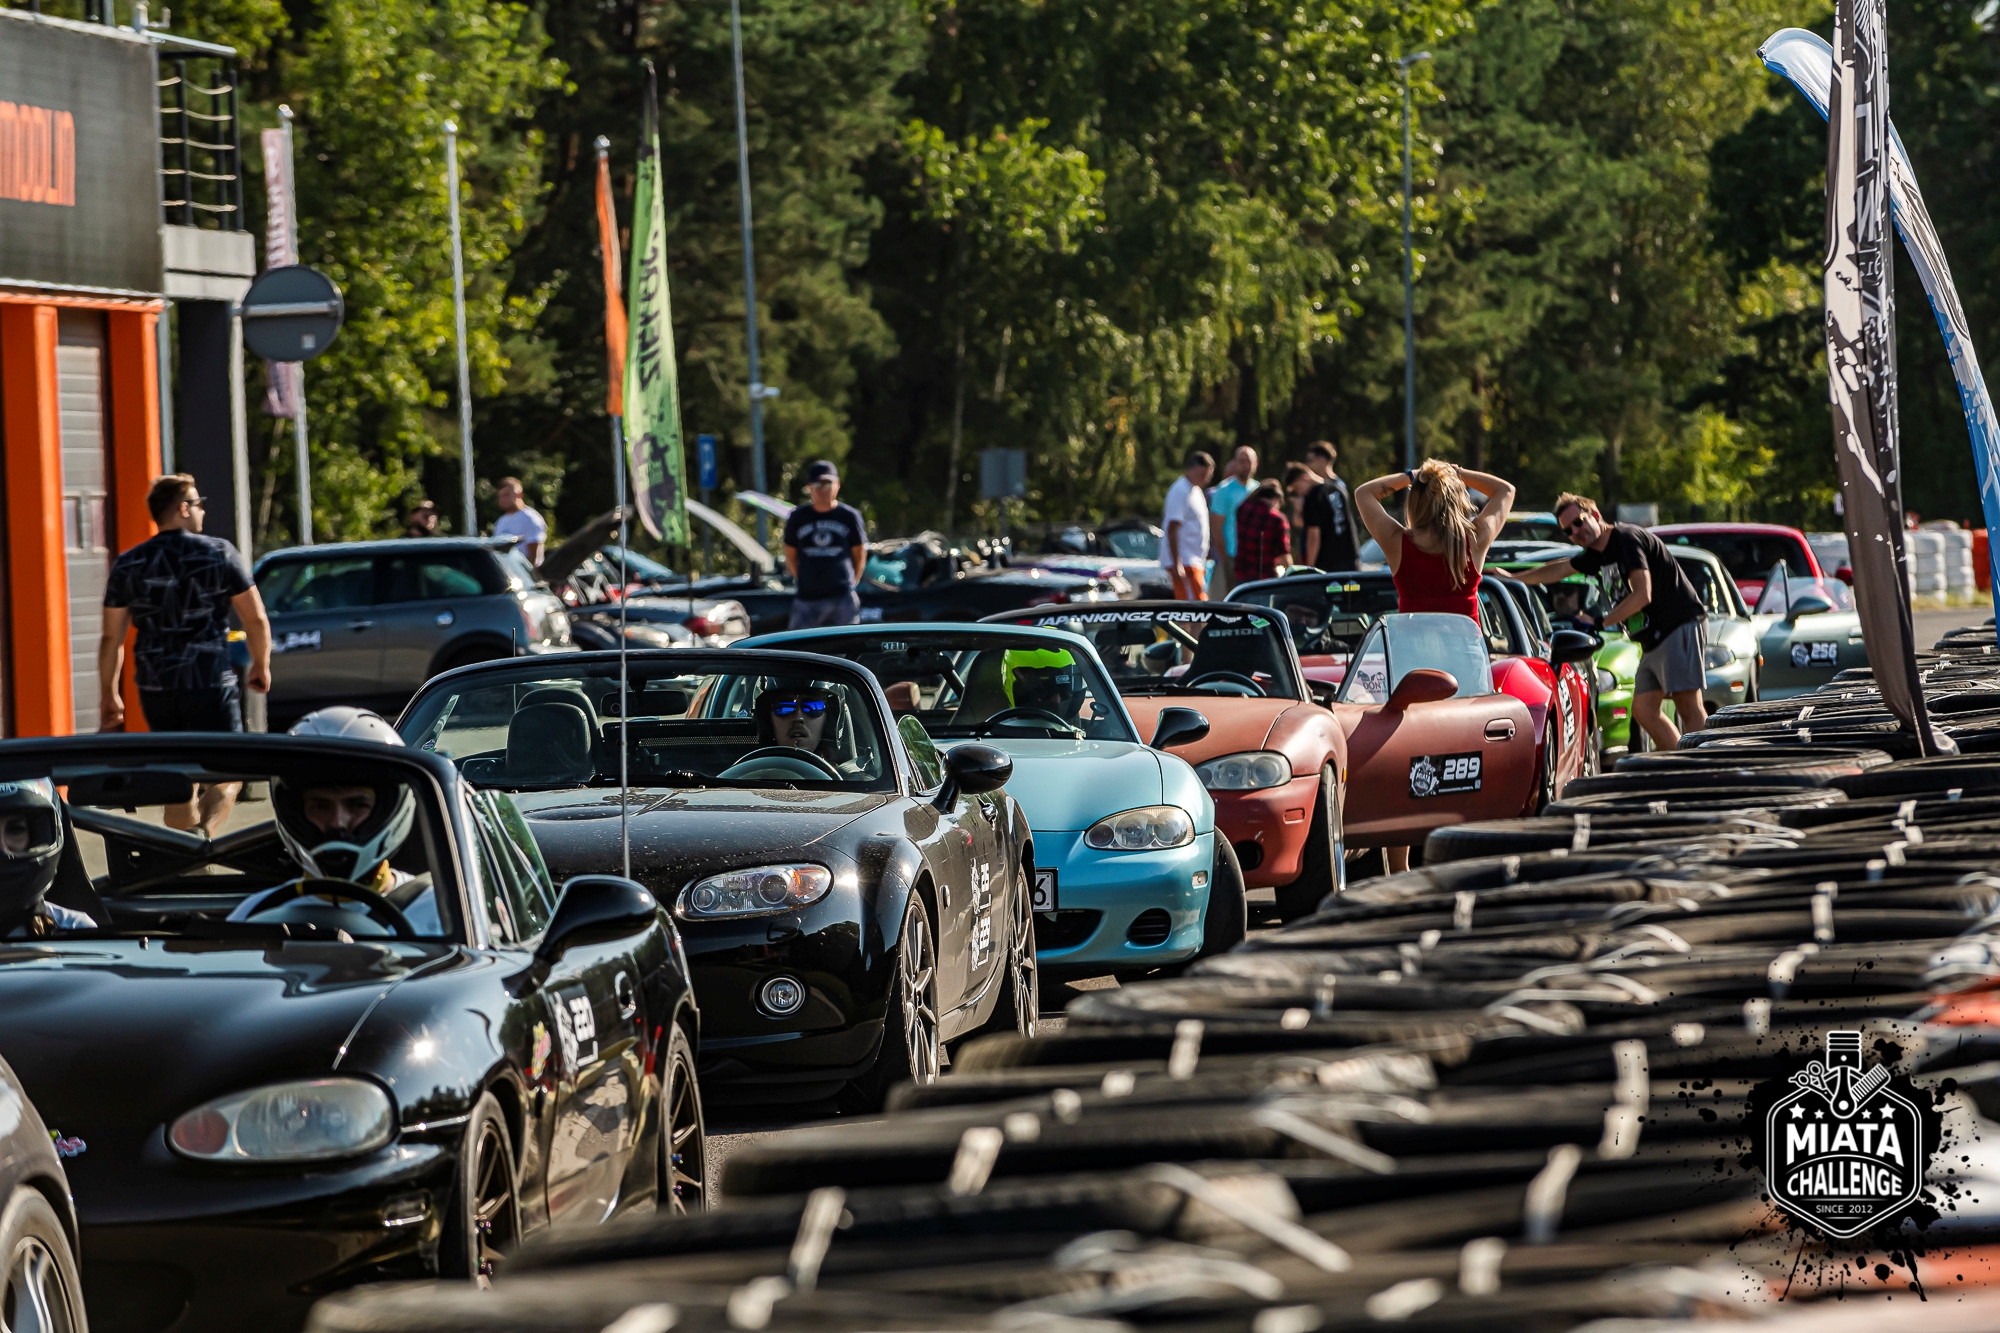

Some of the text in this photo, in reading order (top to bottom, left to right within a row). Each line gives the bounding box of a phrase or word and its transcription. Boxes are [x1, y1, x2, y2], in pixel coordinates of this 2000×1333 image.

[1035, 611, 1213, 627] JAPANKINGZ CREW
[1207, 628, 1263, 638] BRIDE
[1443, 757, 1481, 780] 289
